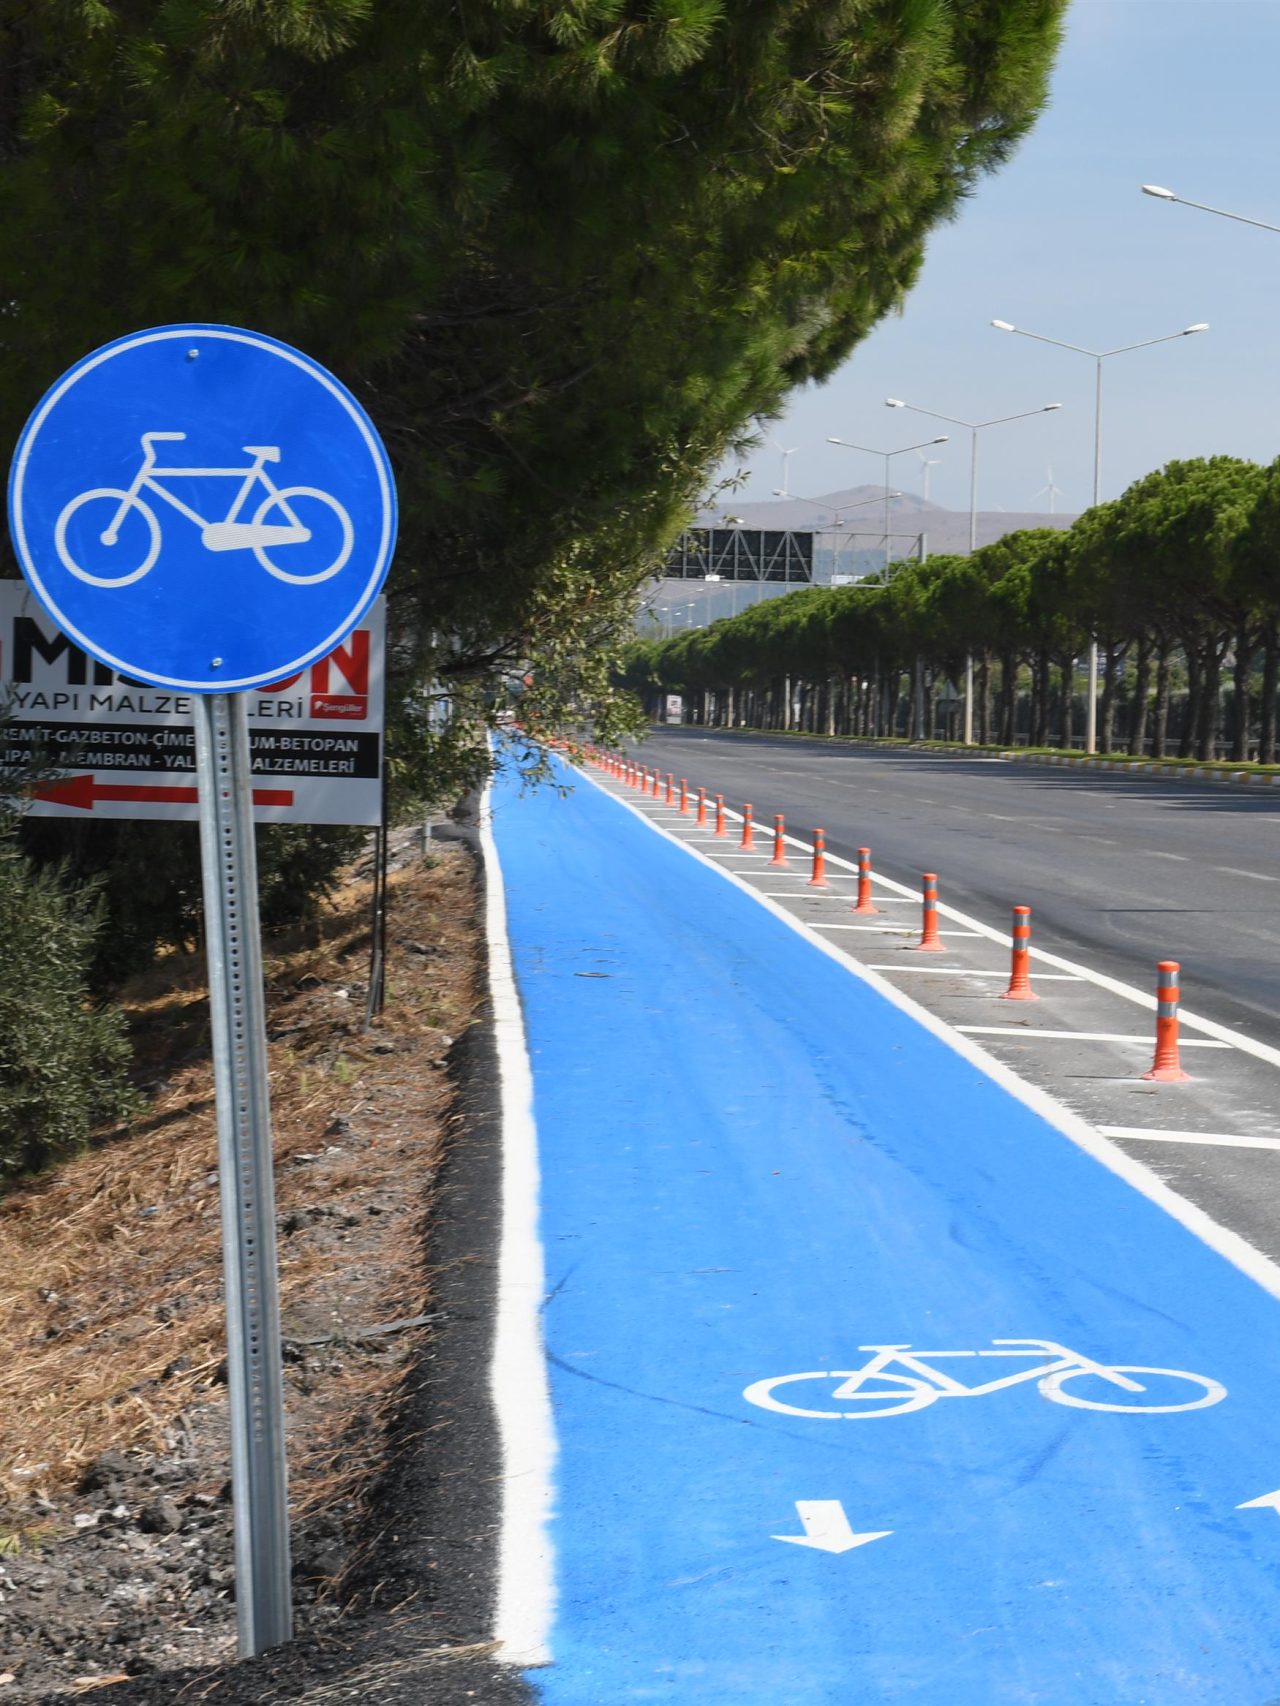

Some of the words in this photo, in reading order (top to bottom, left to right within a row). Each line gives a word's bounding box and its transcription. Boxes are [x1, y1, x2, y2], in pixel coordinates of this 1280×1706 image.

[14, 691, 78, 711] YAPI
[90, 694, 303, 719] MALZEERİ
[252, 758, 355, 773] ALZEMELERİ
